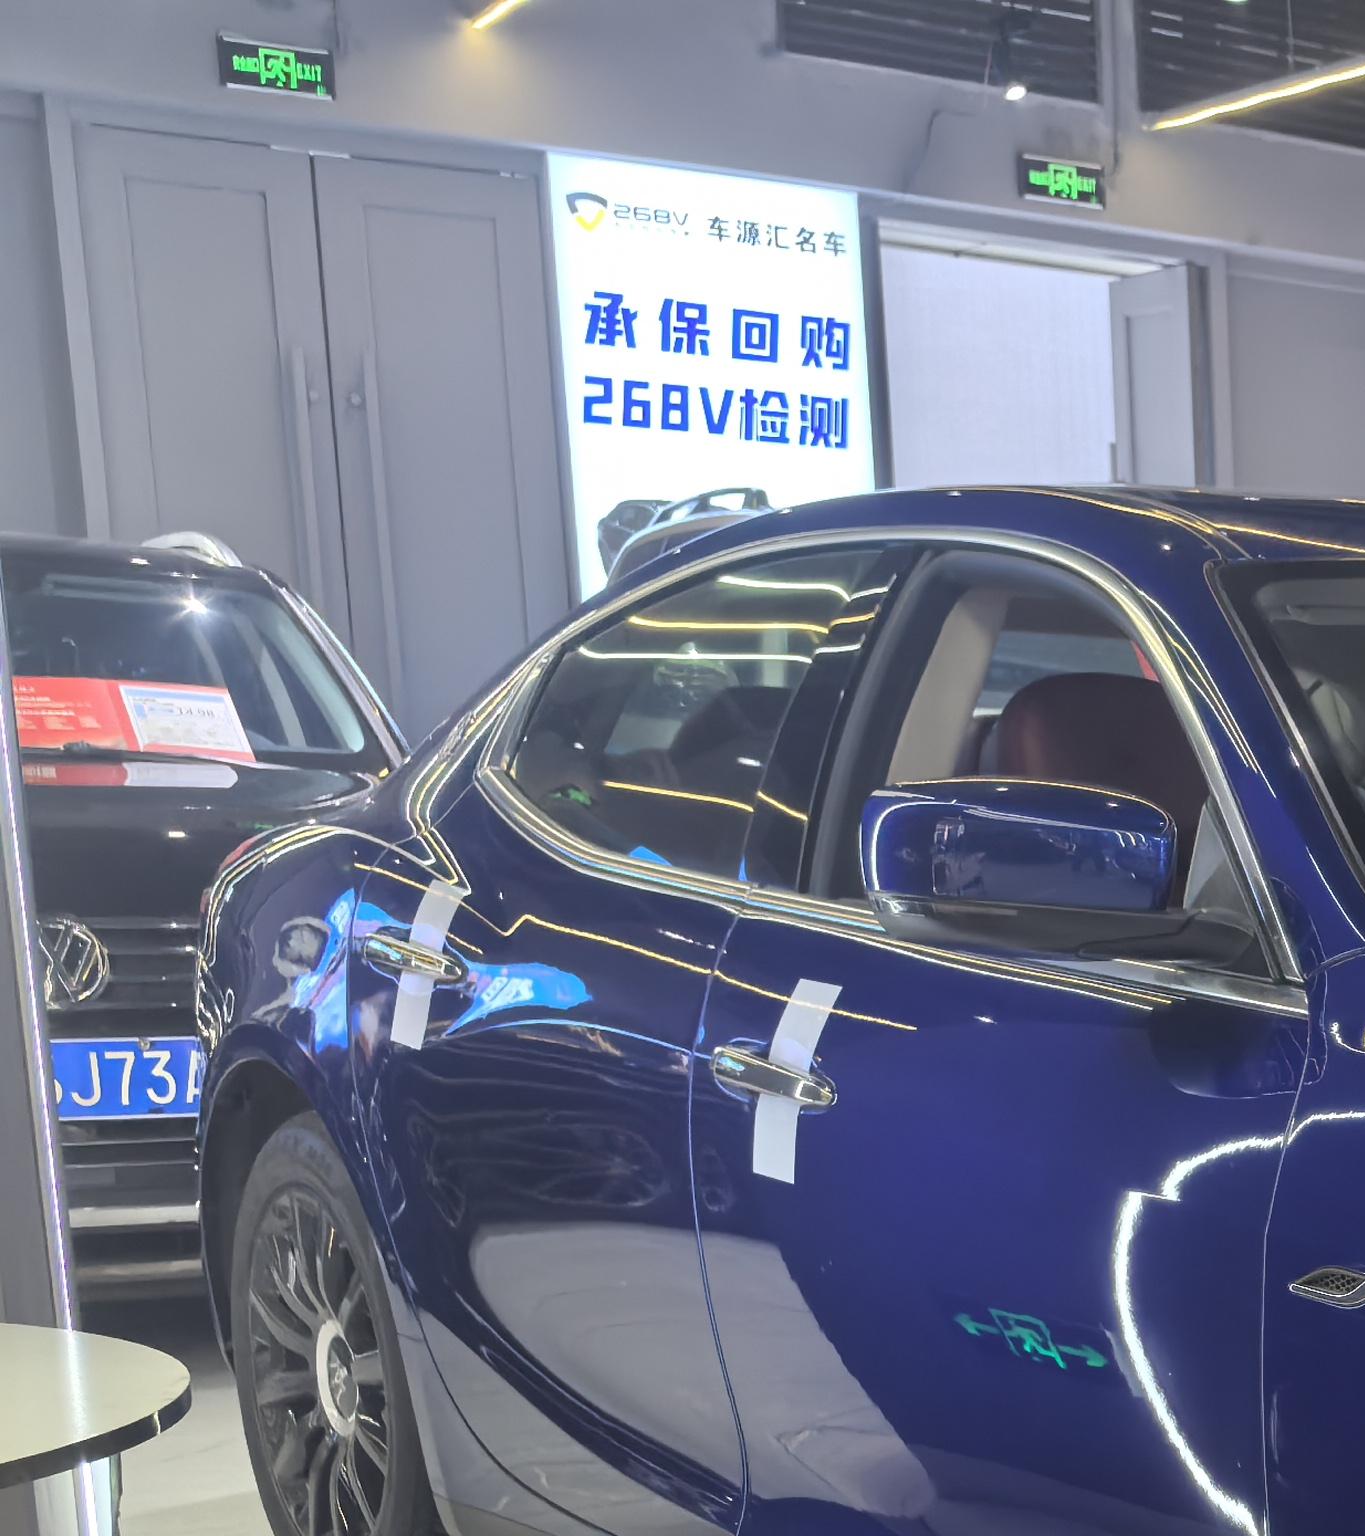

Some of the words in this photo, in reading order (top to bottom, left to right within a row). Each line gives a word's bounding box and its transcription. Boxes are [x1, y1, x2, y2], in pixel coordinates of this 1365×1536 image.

[613, 203, 690, 227] 268V
[707, 215, 848, 257] 车源汇名车
[584, 290, 851, 371] 承保回购
[583, 375, 850, 450] 268V检测
